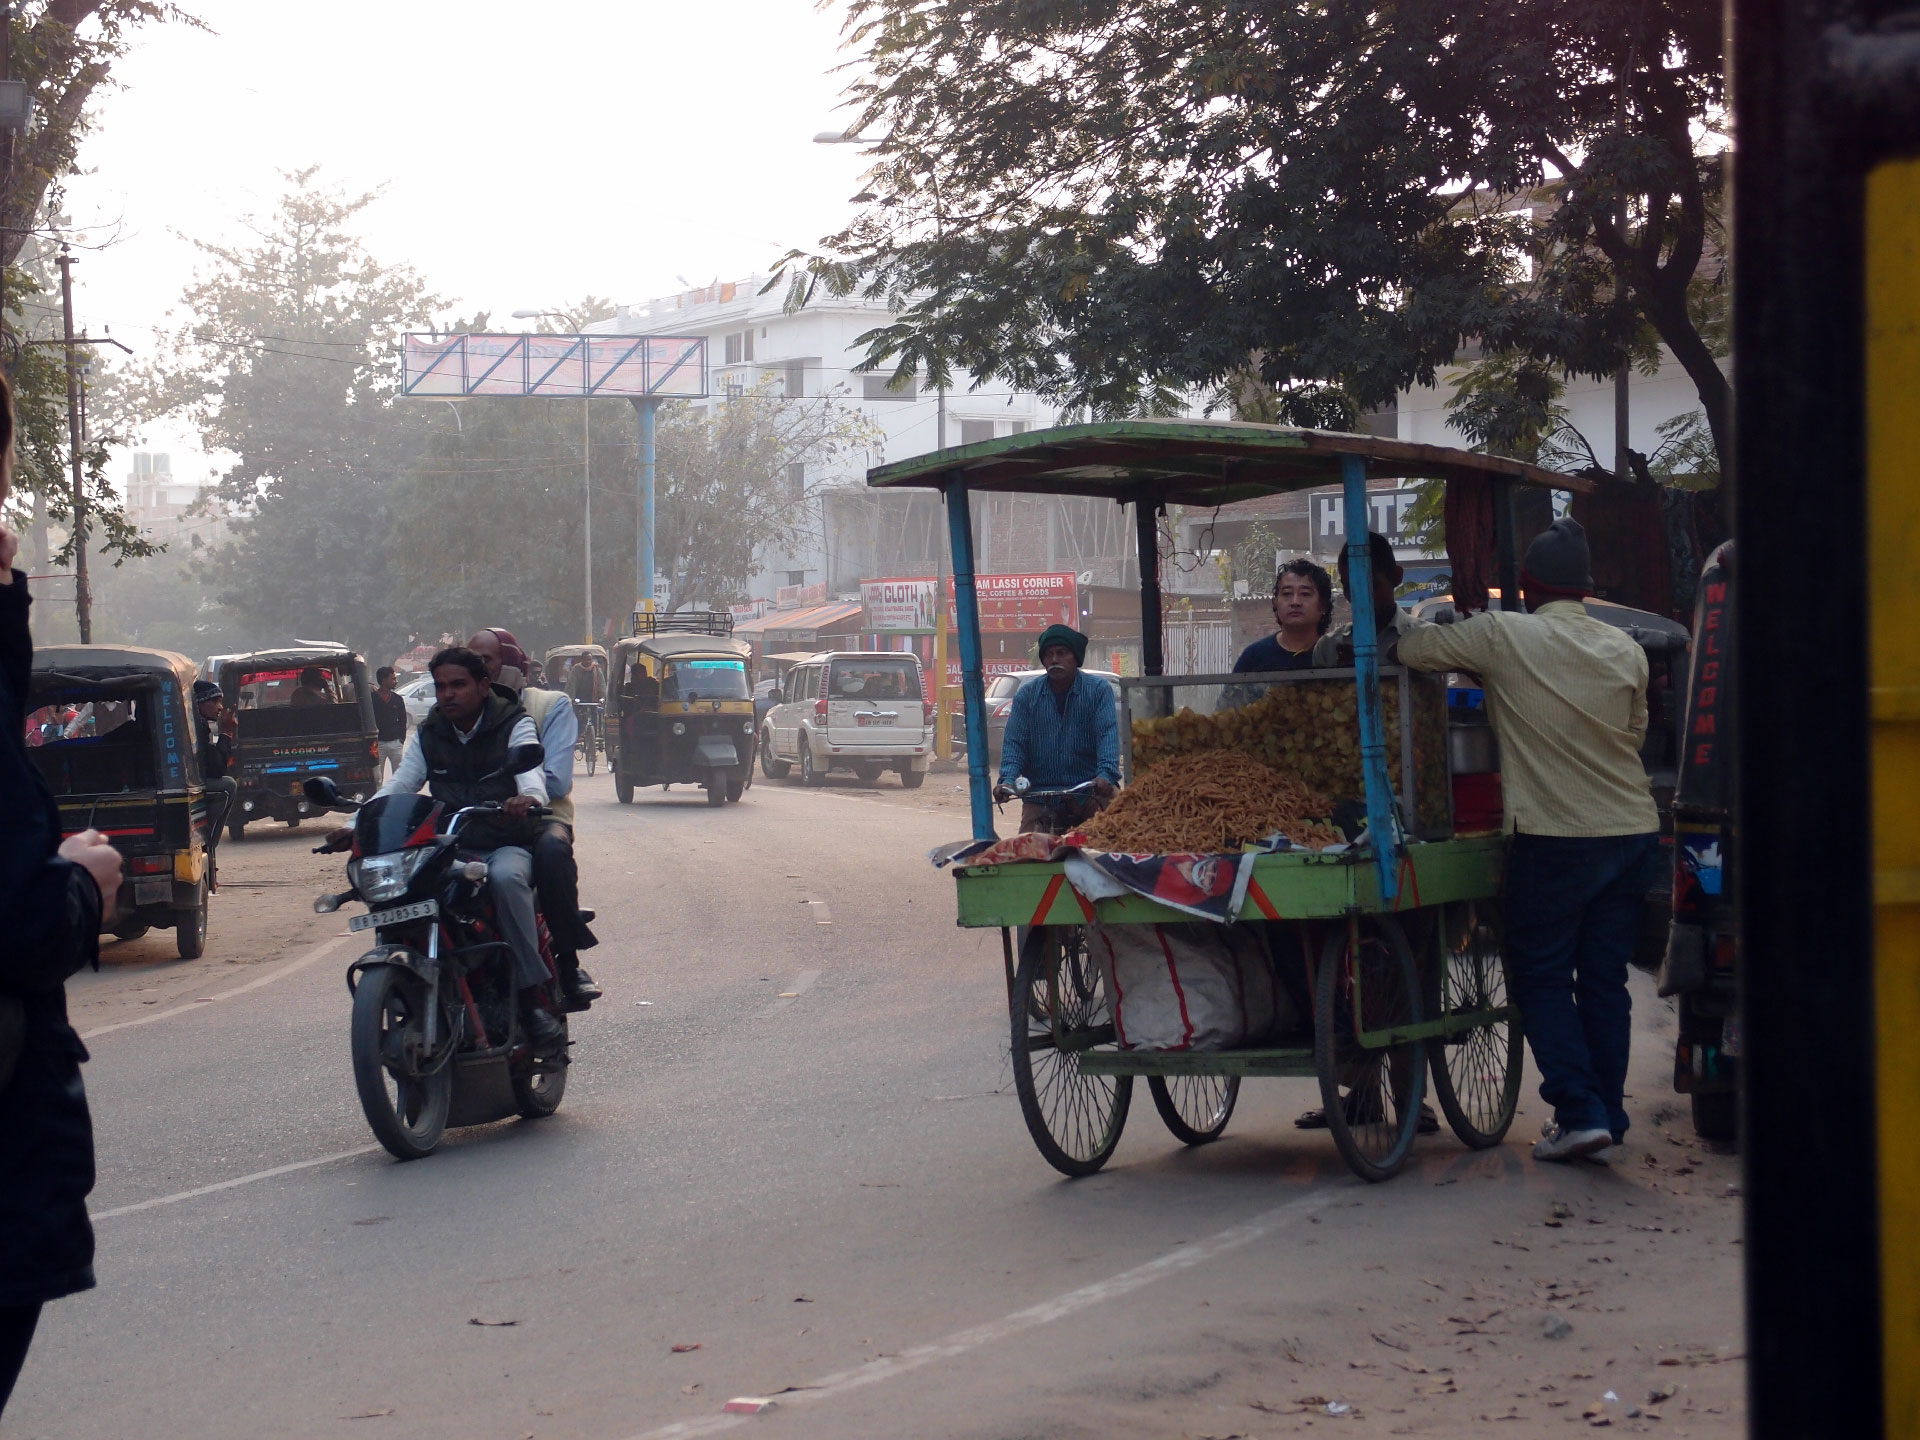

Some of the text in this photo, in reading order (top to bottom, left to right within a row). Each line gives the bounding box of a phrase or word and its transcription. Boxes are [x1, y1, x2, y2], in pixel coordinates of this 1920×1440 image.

[1320, 493, 1438, 536] HTE
[993, 578, 1020, 589] LASSI
[1022, 577, 1064, 588] CORNER
[1026, 588, 1049, 596] FOODS
[885, 584, 918, 603] CLOTH
[986, 664, 1011, 675] LASSI
[1695, 582, 1727, 766] WELCOME
[160, 681, 180, 778] WELCOME
